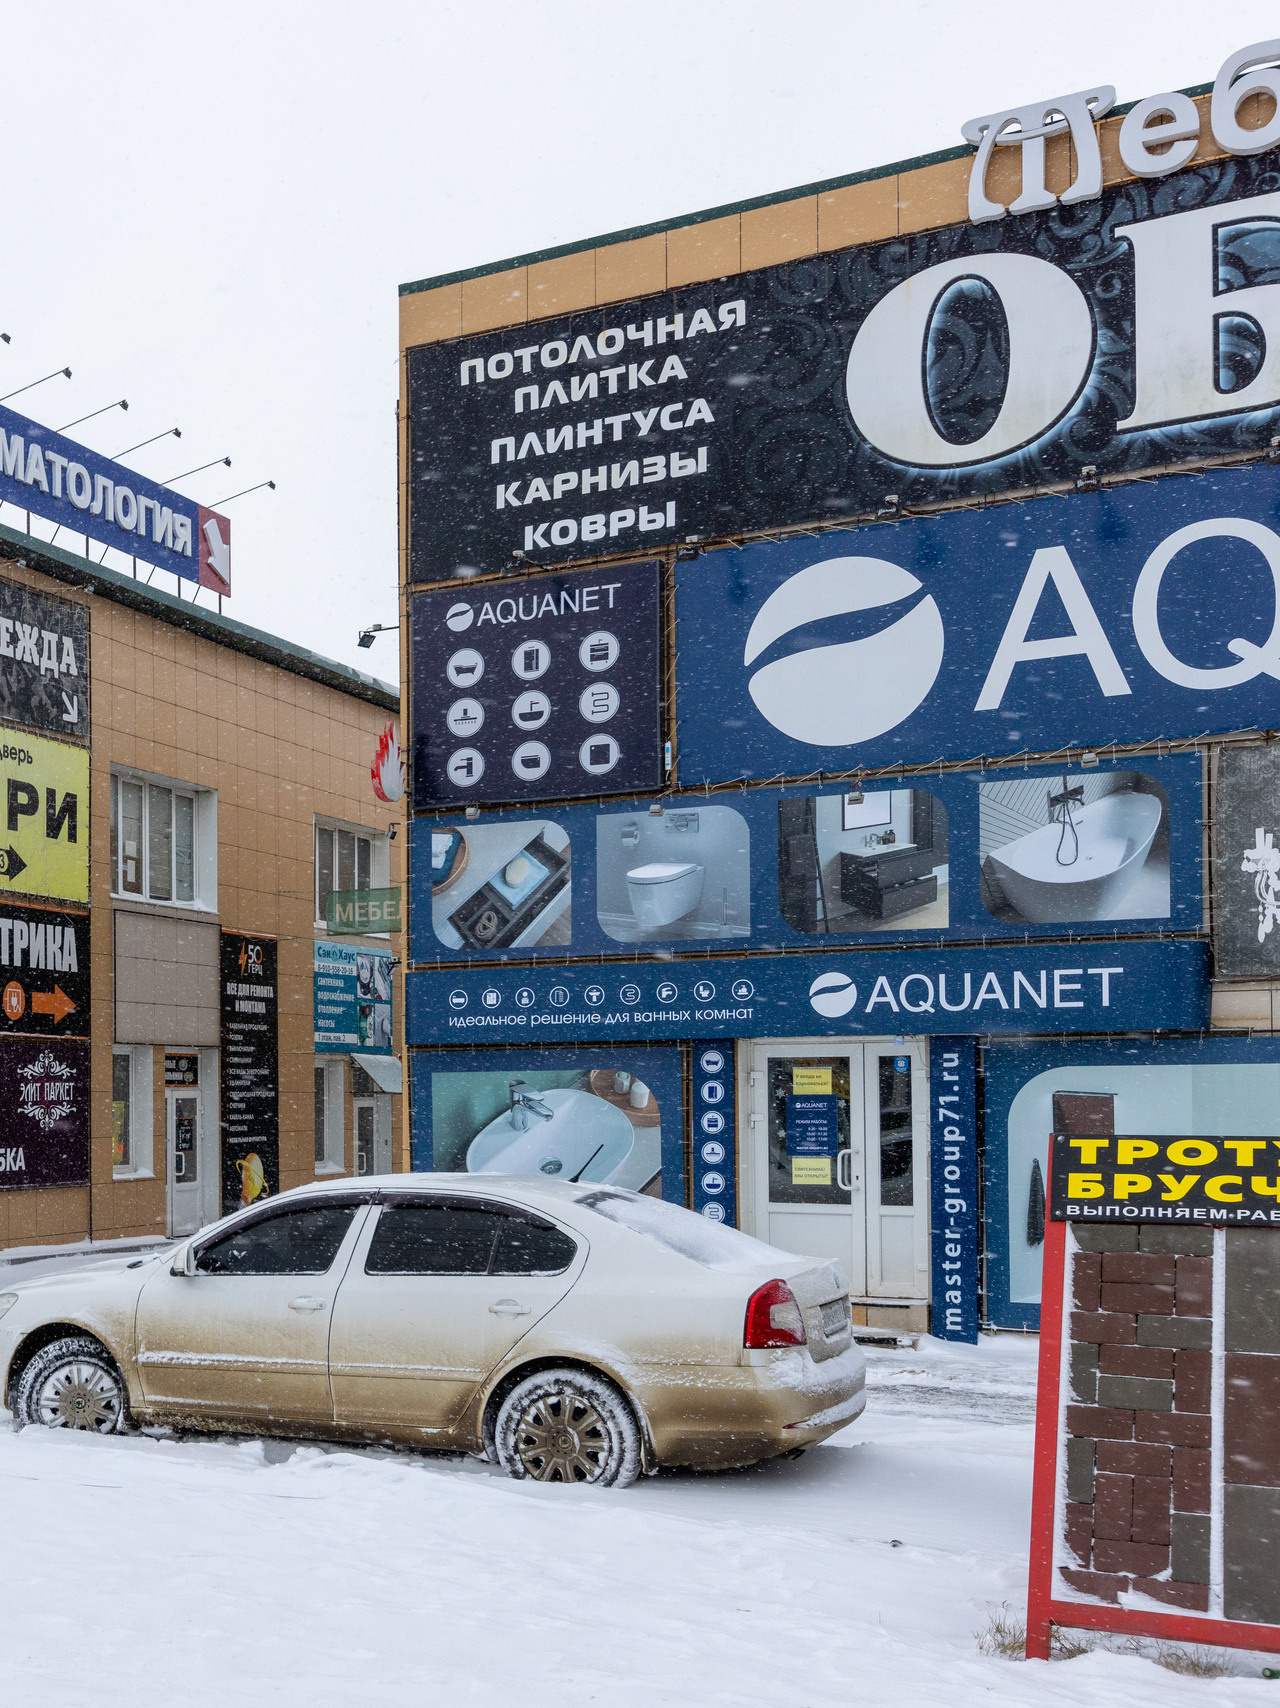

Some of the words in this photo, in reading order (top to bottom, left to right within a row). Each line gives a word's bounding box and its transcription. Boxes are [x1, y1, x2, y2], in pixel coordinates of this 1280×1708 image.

[460, 299, 746, 386] ПОТОЛОЧНАЯ
[514, 354, 688, 414] ПЛИТКА
[491, 398, 715, 465] ПЛИНТУСА
[496, 446, 708, 510] КАРНИЗЫ
[524, 500, 677, 551] КОВРЫ
[477, 583, 622, 627] AQUANET
[248, 945, 263, 964] 50
[317, 946, 331, 959] Сан
[338, 949, 355, 965] Хаус
[248, 964, 263, 976] ГЕРЦ
[227, 982, 237, 995] ВСЕ
[238, 983, 249, 997] ДЛЯ
[250, 984, 273, 998] РЕМОНТА
[318, 977, 344, 987] сантехника
[865, 967, 1124, 1014] AQUANET
[318, 990, 354, 1001] водоснабжение
[318, 1005, 343, 1015] отопление
[449, 1013, 527, 1028] идеальное
[530, 1011, 601, 1027] решение
[604, 1010, 630, 1025] для
[634, 1009, 691, 1023] ванных
[695, 1007, 754, 1020] комнат
[318, 1018, 335, 1028] насосы
[20, 1083, 40, 1101] ЭЛИТ
[44, 1082, 74, 1101] ПАРКЕТ
[938, 1053, 967, 1331] master-group71.ru
[1067, 1173, 1280, 1203] БРУСЧ
[1066, 1205, 1227, 1219] ВЫПОЛНЯЕМ
